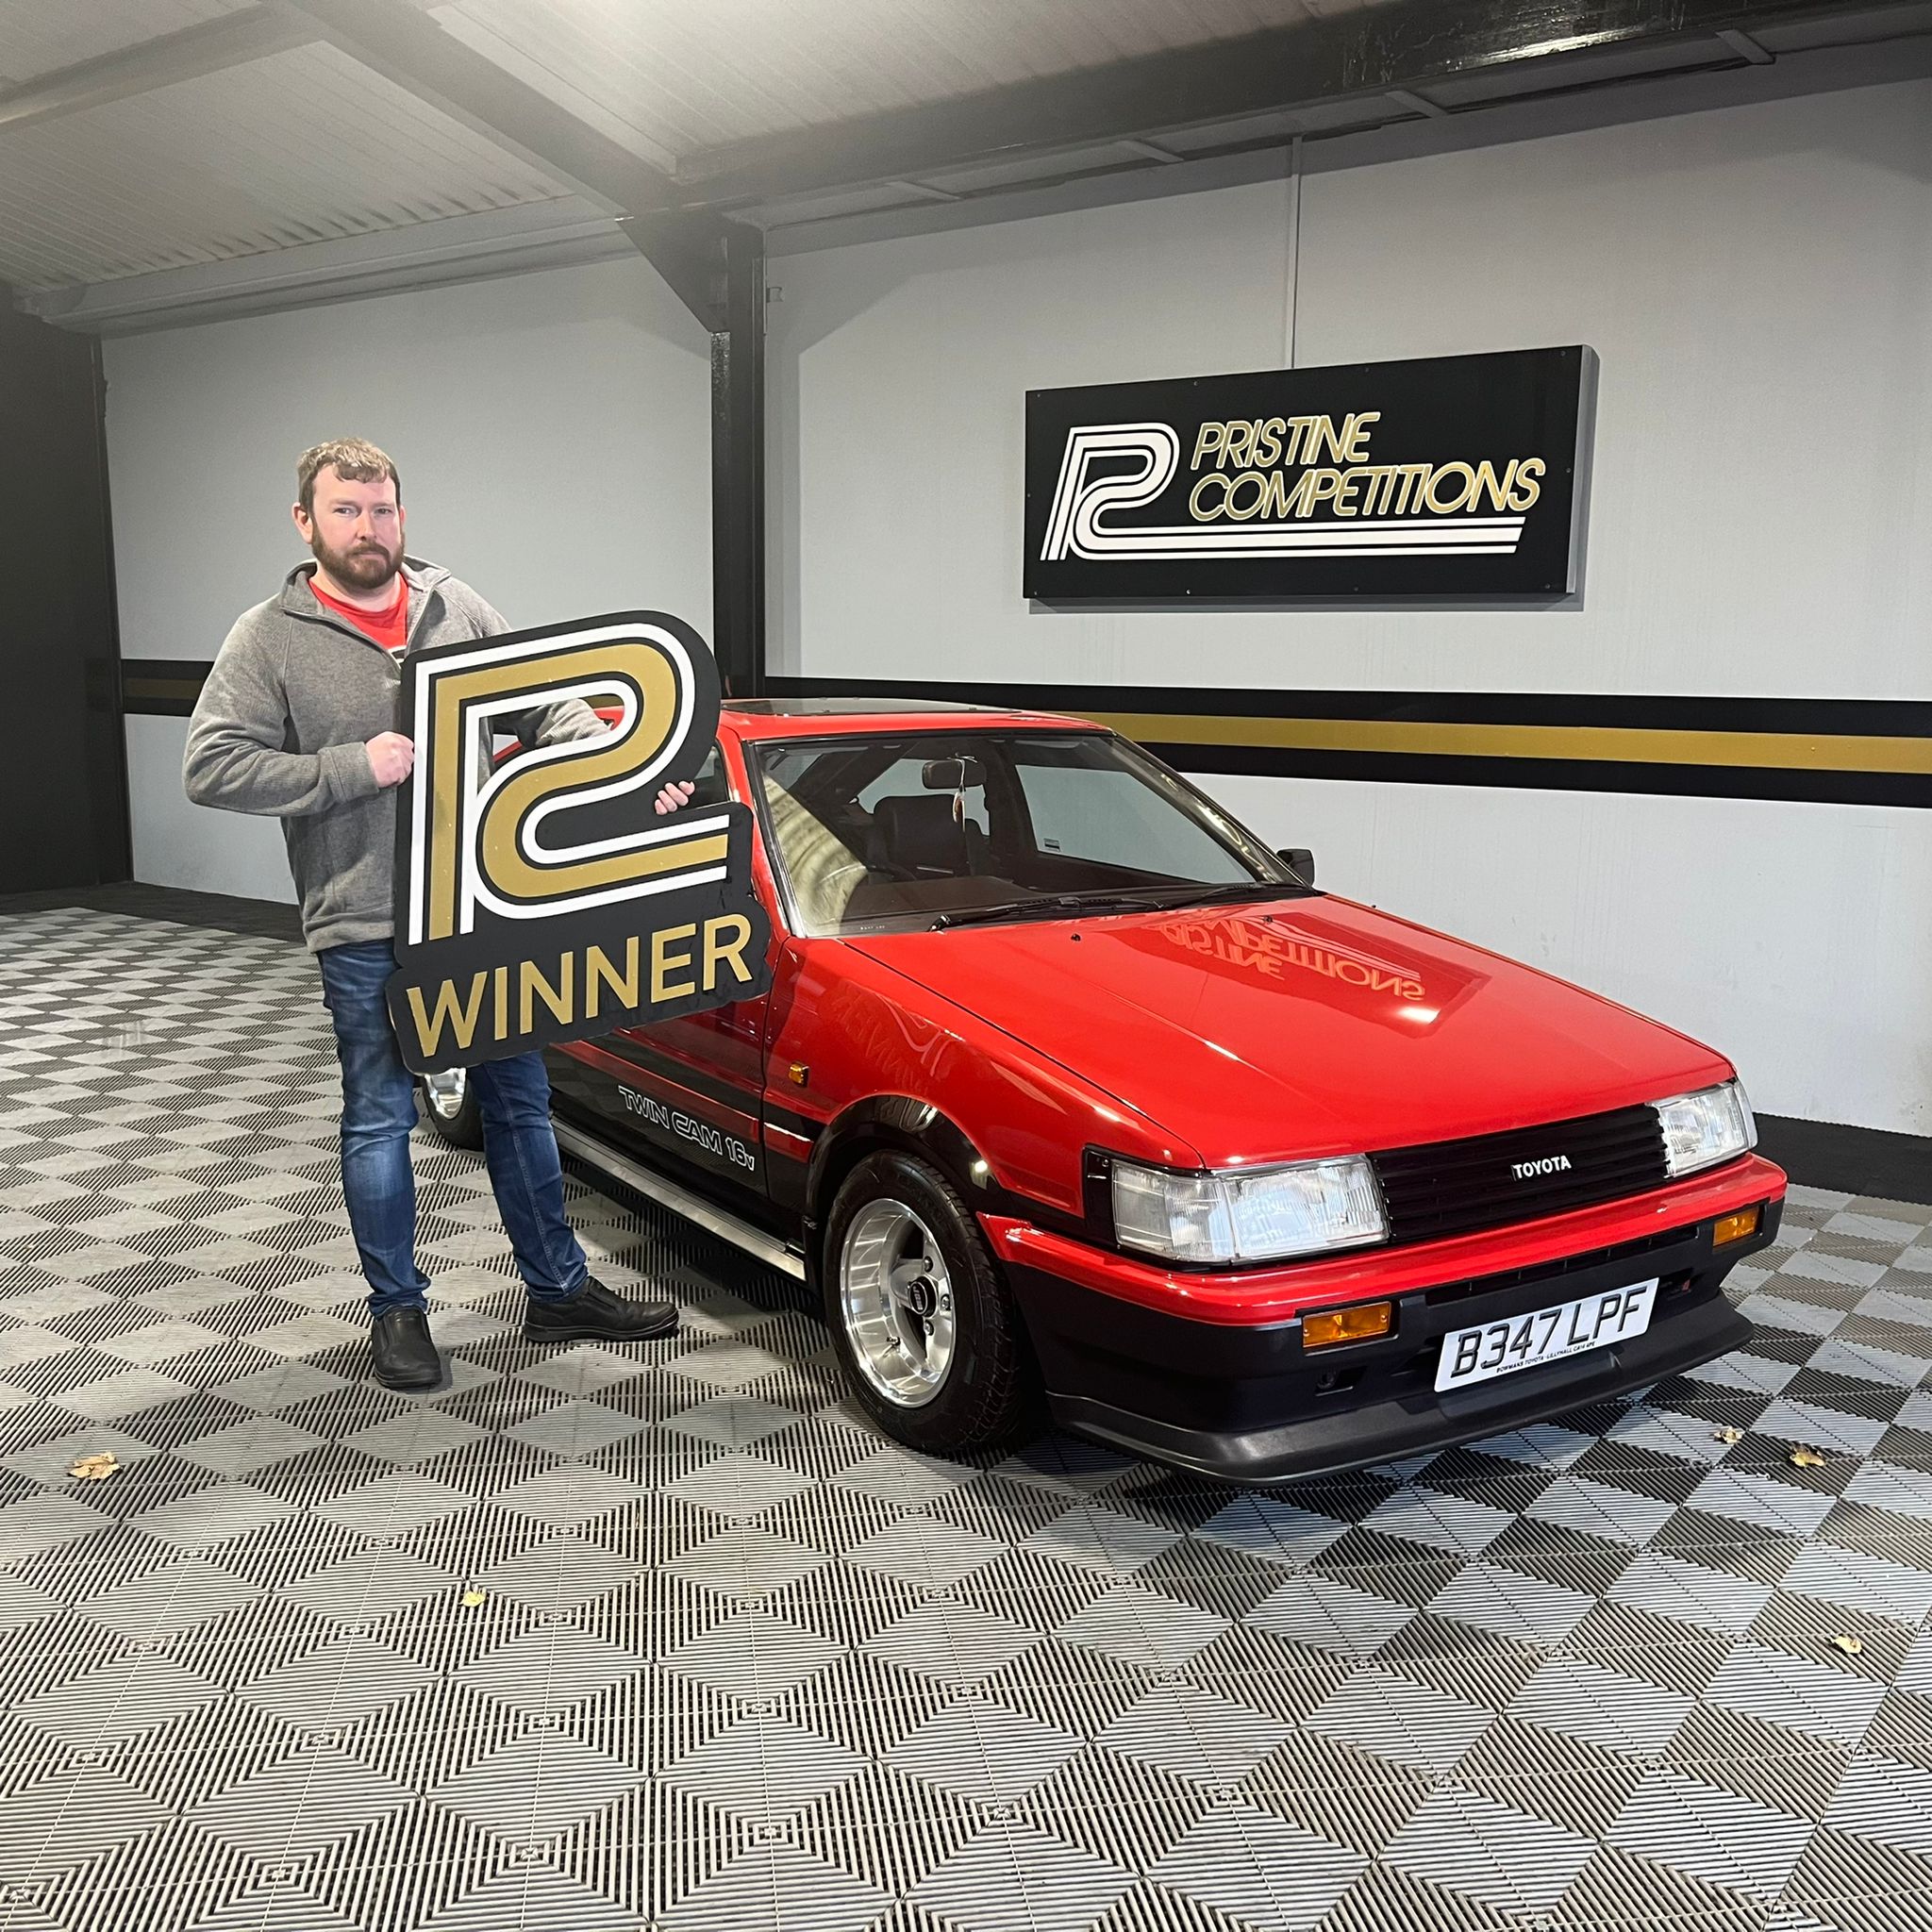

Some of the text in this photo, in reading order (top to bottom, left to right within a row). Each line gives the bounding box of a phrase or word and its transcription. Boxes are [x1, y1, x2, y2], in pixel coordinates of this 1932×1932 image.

[1191, 411, 1381, 471] PRISTINE
[1189, 458, 1546, 522] COMPETITIONS
[406, 913, 753, 1058] WINNER
[618, 1085, 670, 1129] TWIN
[672, 1111, 723, 1156] CAM
[1512, 1155, 1572, 1178] TOYOTA
[1450, 1285, 1647, 1378] B347 LPF
[1496, 1361, 1524, 1373] BOWMANS
[1524, 1356, 1544, 1365] TOYOTA
